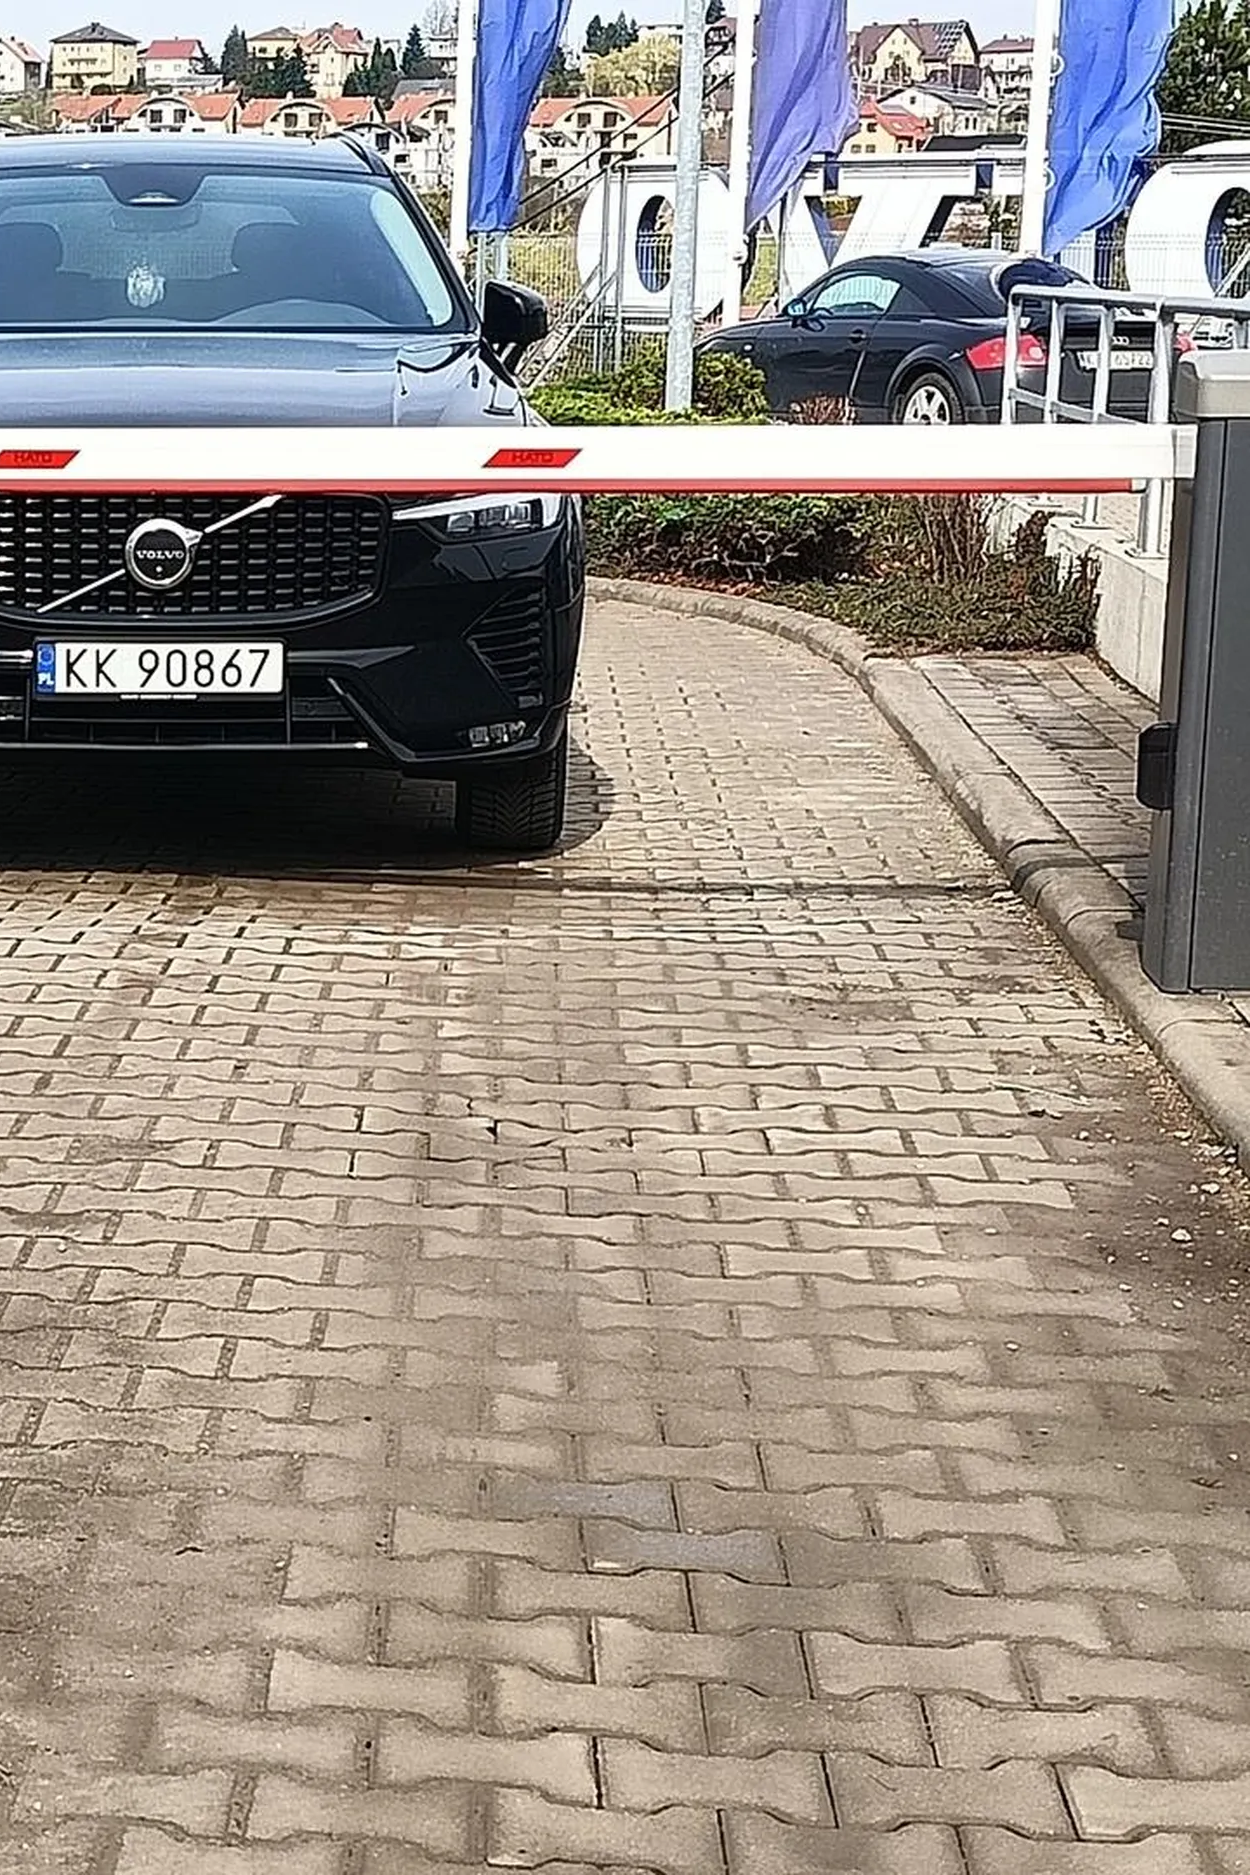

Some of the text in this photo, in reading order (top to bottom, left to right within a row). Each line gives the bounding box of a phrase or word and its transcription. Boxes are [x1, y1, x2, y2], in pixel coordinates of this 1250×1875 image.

[136, 550, 185, 559] VOLVO
[65, 648, 270, 687] KK 90867
[38, 673, 54, 685] PL
